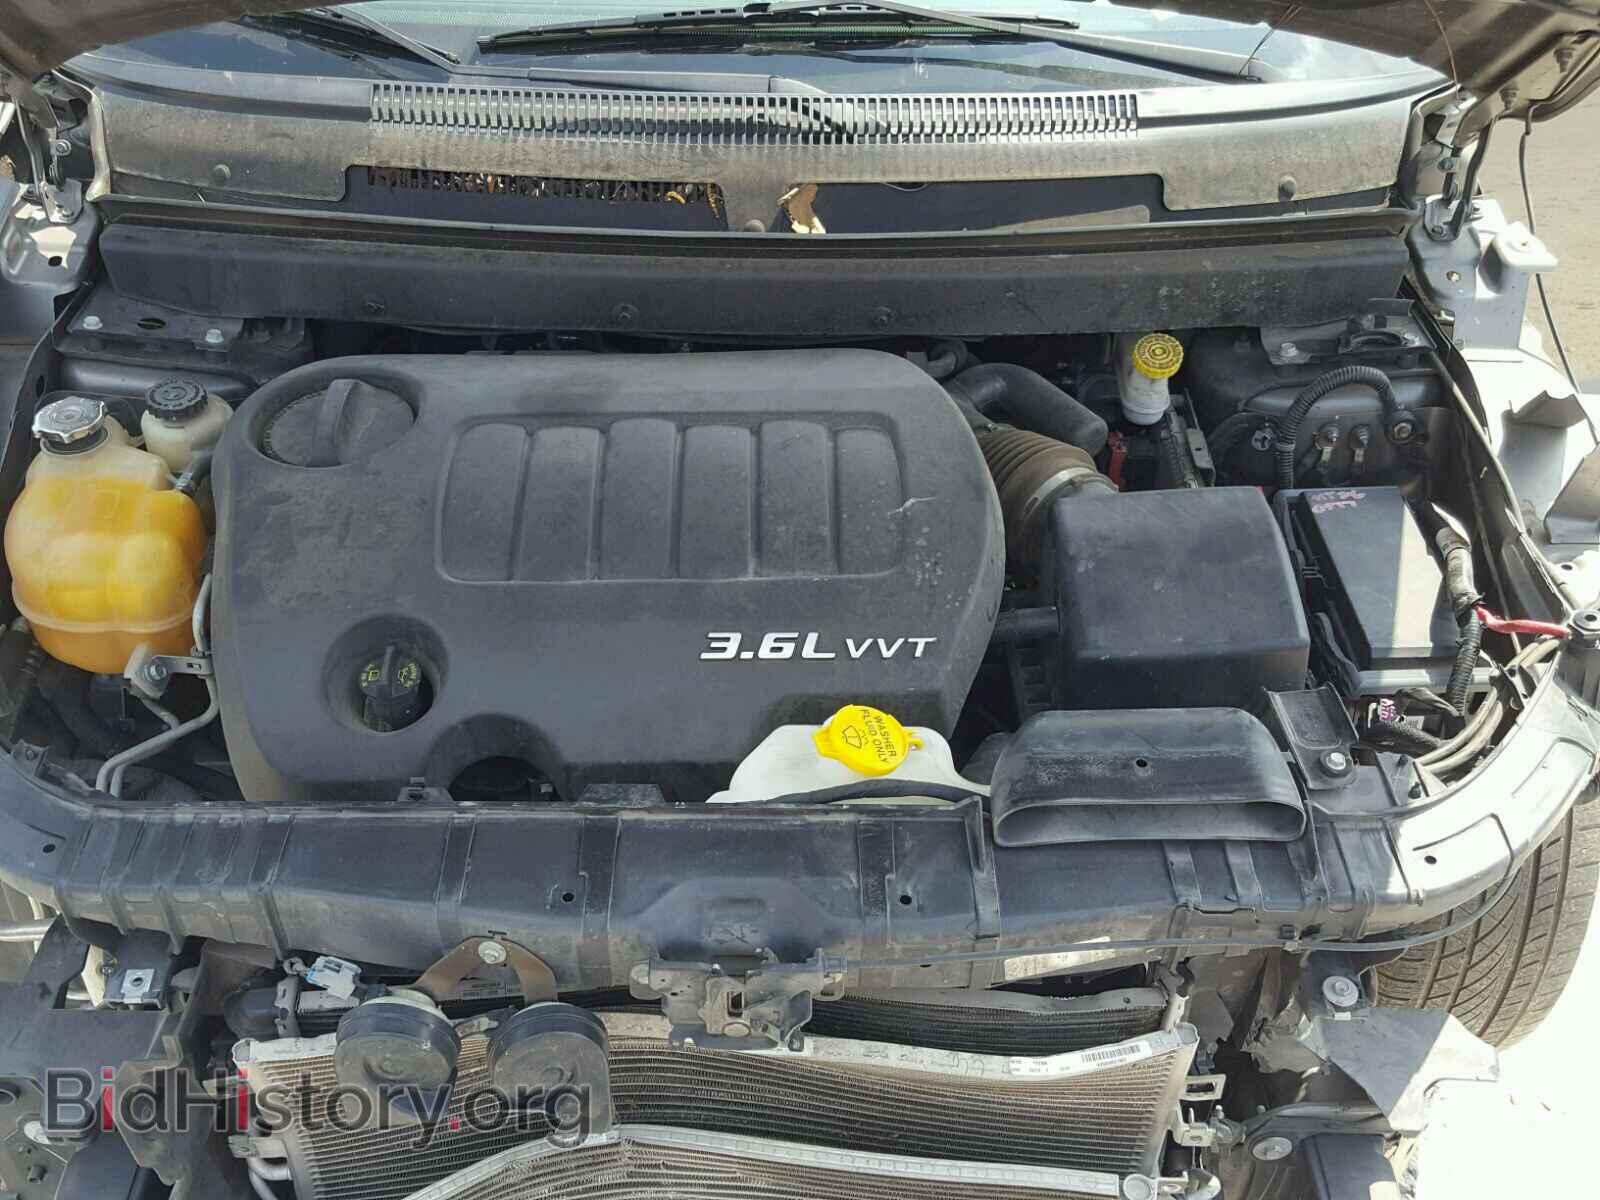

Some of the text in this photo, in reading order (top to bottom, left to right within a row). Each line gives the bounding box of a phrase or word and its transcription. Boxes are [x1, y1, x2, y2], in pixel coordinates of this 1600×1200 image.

[700, 631, 938, 660] 3.6L VVT
[861, 709, 889, 763] FLUID ONLY
[873, 715, 897, 757] WASHER
